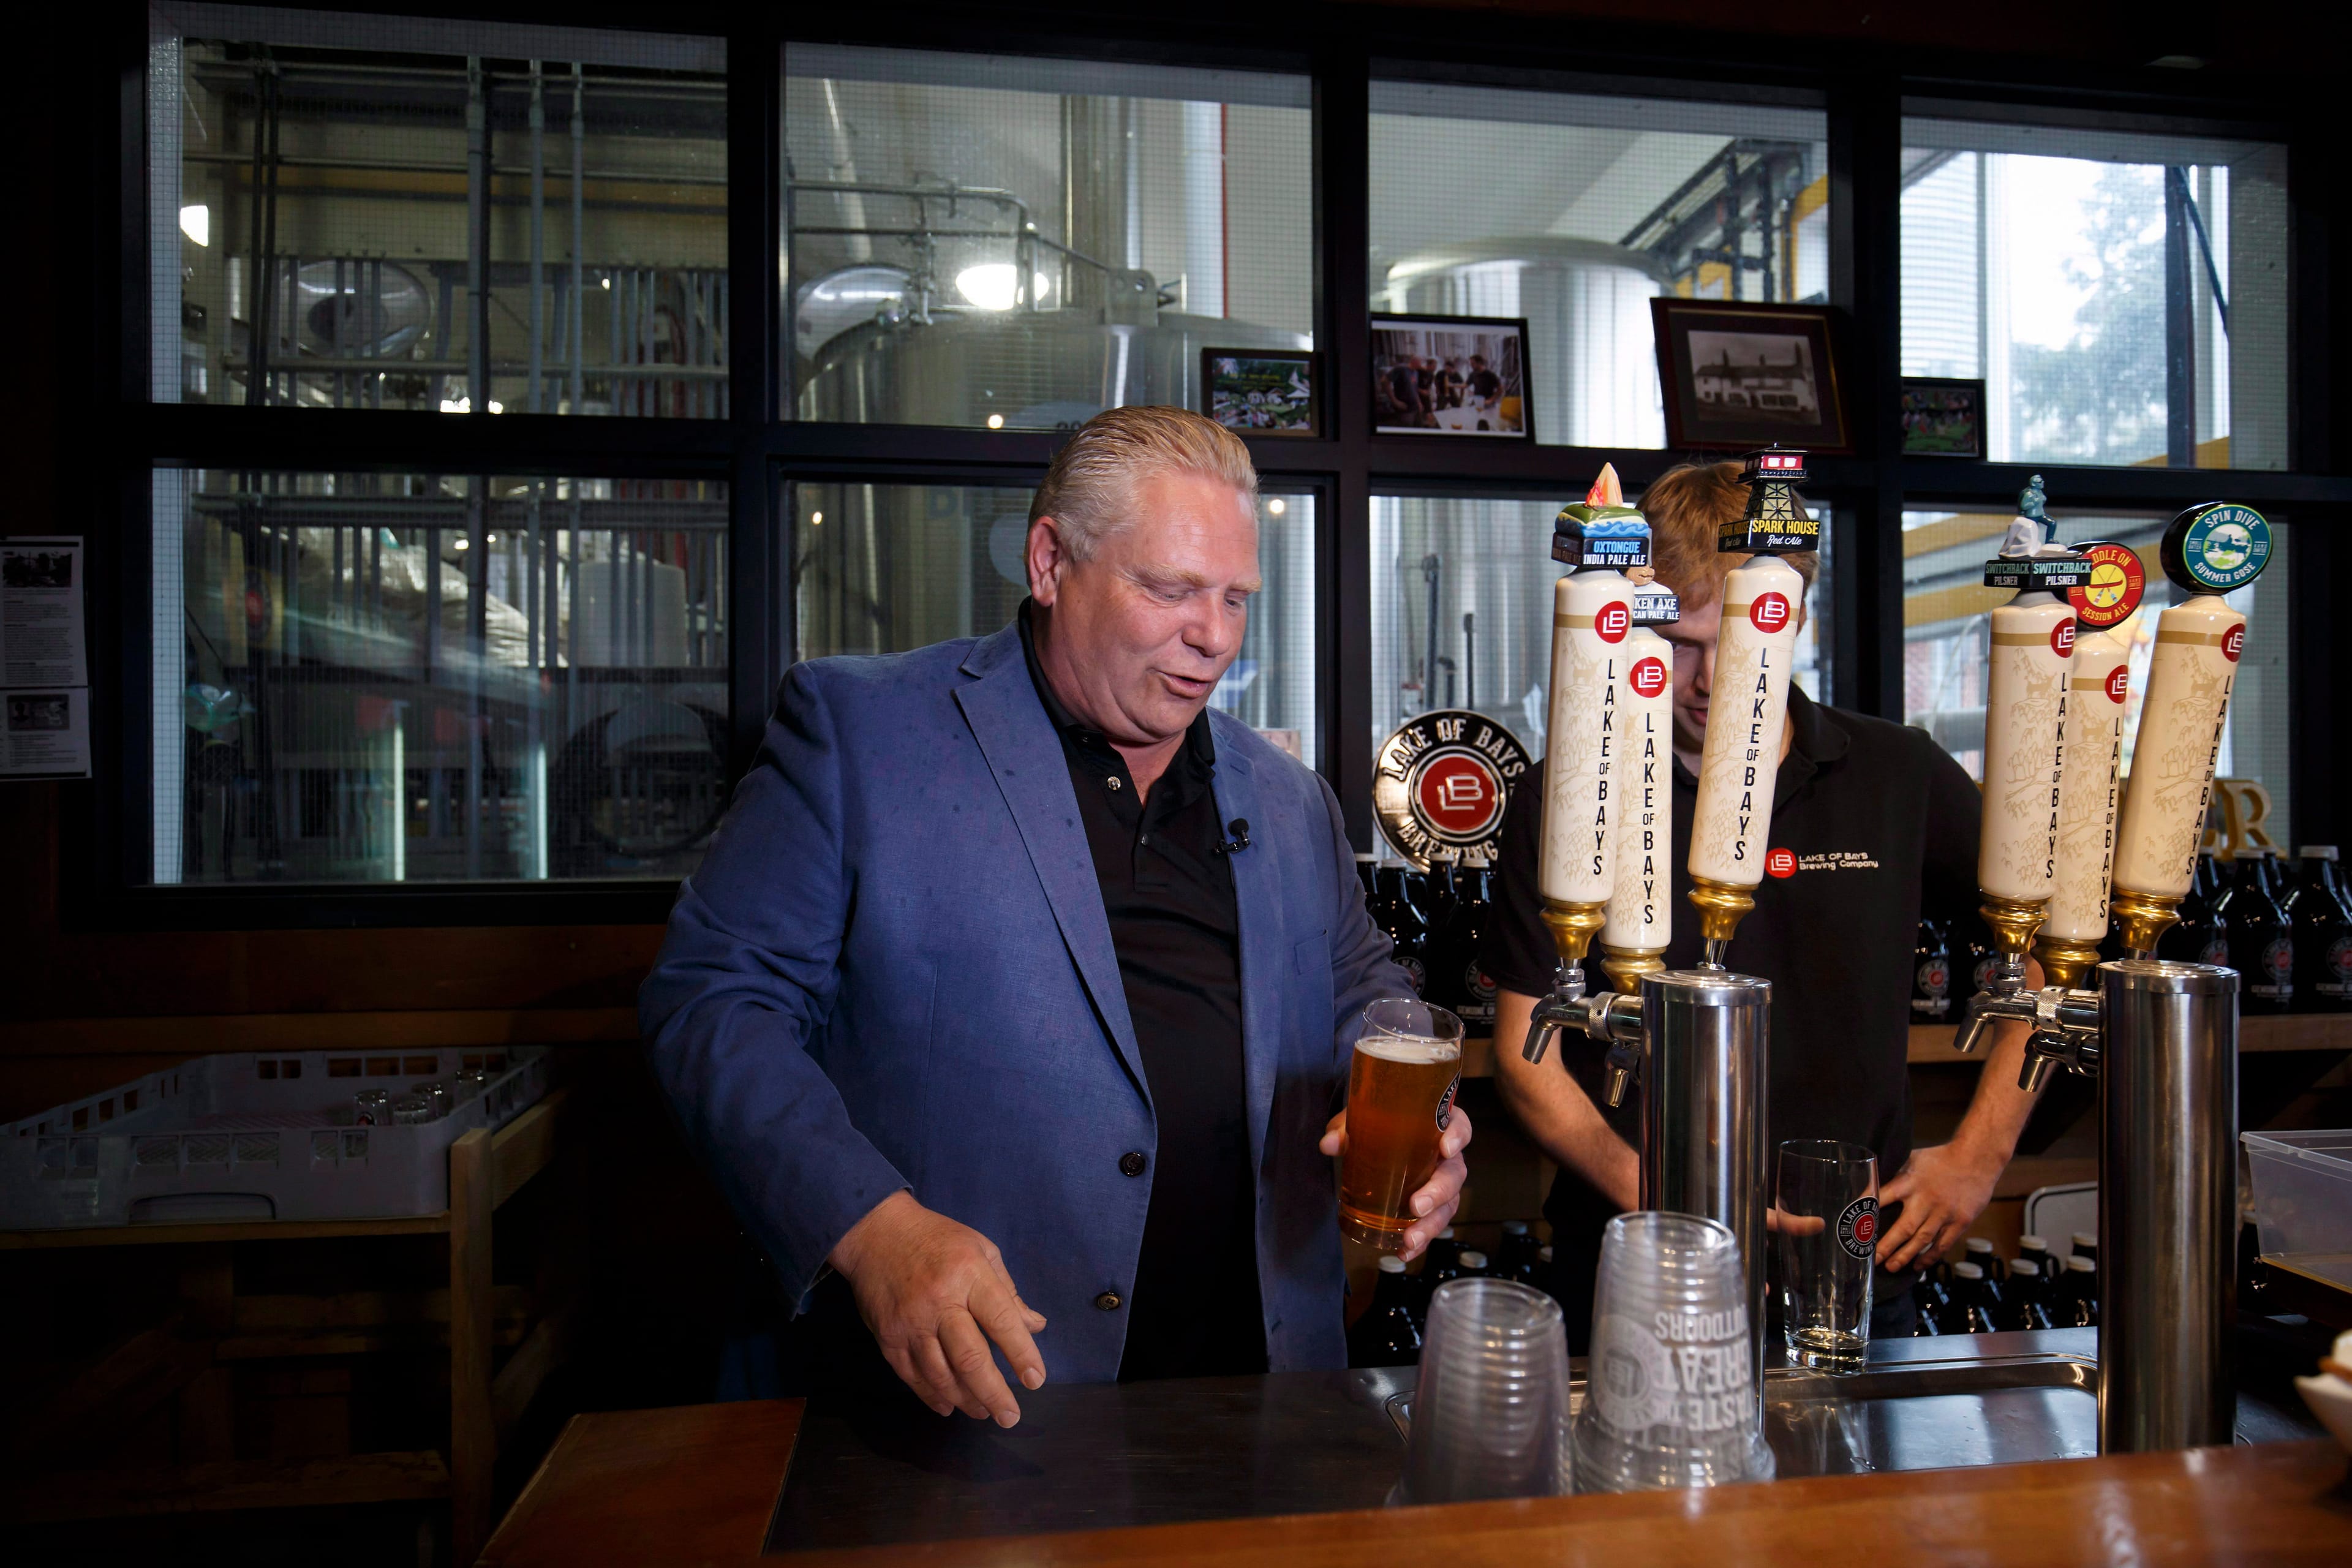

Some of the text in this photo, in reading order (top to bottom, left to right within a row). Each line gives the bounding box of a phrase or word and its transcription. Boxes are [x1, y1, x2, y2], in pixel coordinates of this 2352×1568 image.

[1752, 520, 1819, 535] SPARK HOUSE
[2205, 510, 2260, 530] SPIN DIVE
[1594, 541, 1640, 553] OXTONGUE
[1767, 535, 1803, 546] Red Ale
[1583, 554, 1646, 565] INDIA PALE ALE
[2091, 549, 2132, 567] DDLE ON
[1986, 564, 2029, 575] SWITCHBACK
[2033, 562, 2091, 575] SWITCHBACK
[2194, 562, 2256, 582] SUMMER GOSE
[1994, 576, 2018, 586] PILSNER
[2045, 575, 2077, 586] PILSNER
[1656, 598, 1676, 610] AXE
[2081, 603, 2130, 620] SESSION ALE
[1648, 611, 1665, 619] PALE
[1382, 718, 1526, 781] LAKE OF BAYS
[1734, 647, 1770, 861] LAKE OF BAYS
[1593, 658, 1616, 875] LAKE OF BAYS
[2046, 673, 2067, 878] LAKE OF BAYS
[2186, 676, 2231, 875] LAKE OF BAYS
[1643, 712, 1655, 924] LAKE OF BAYS
[2100, 717, 2120, 918] LAKE OF BAYS
[1799, 854, 1825, 862] LAKE
[1844, 852, 1868, 861] BAYS
[1799, 859, 1879, 871] Brewing Company
[1843, 1204, 1861, 1224] LAKE
[1863, 1200, 1871, 1210] OF
